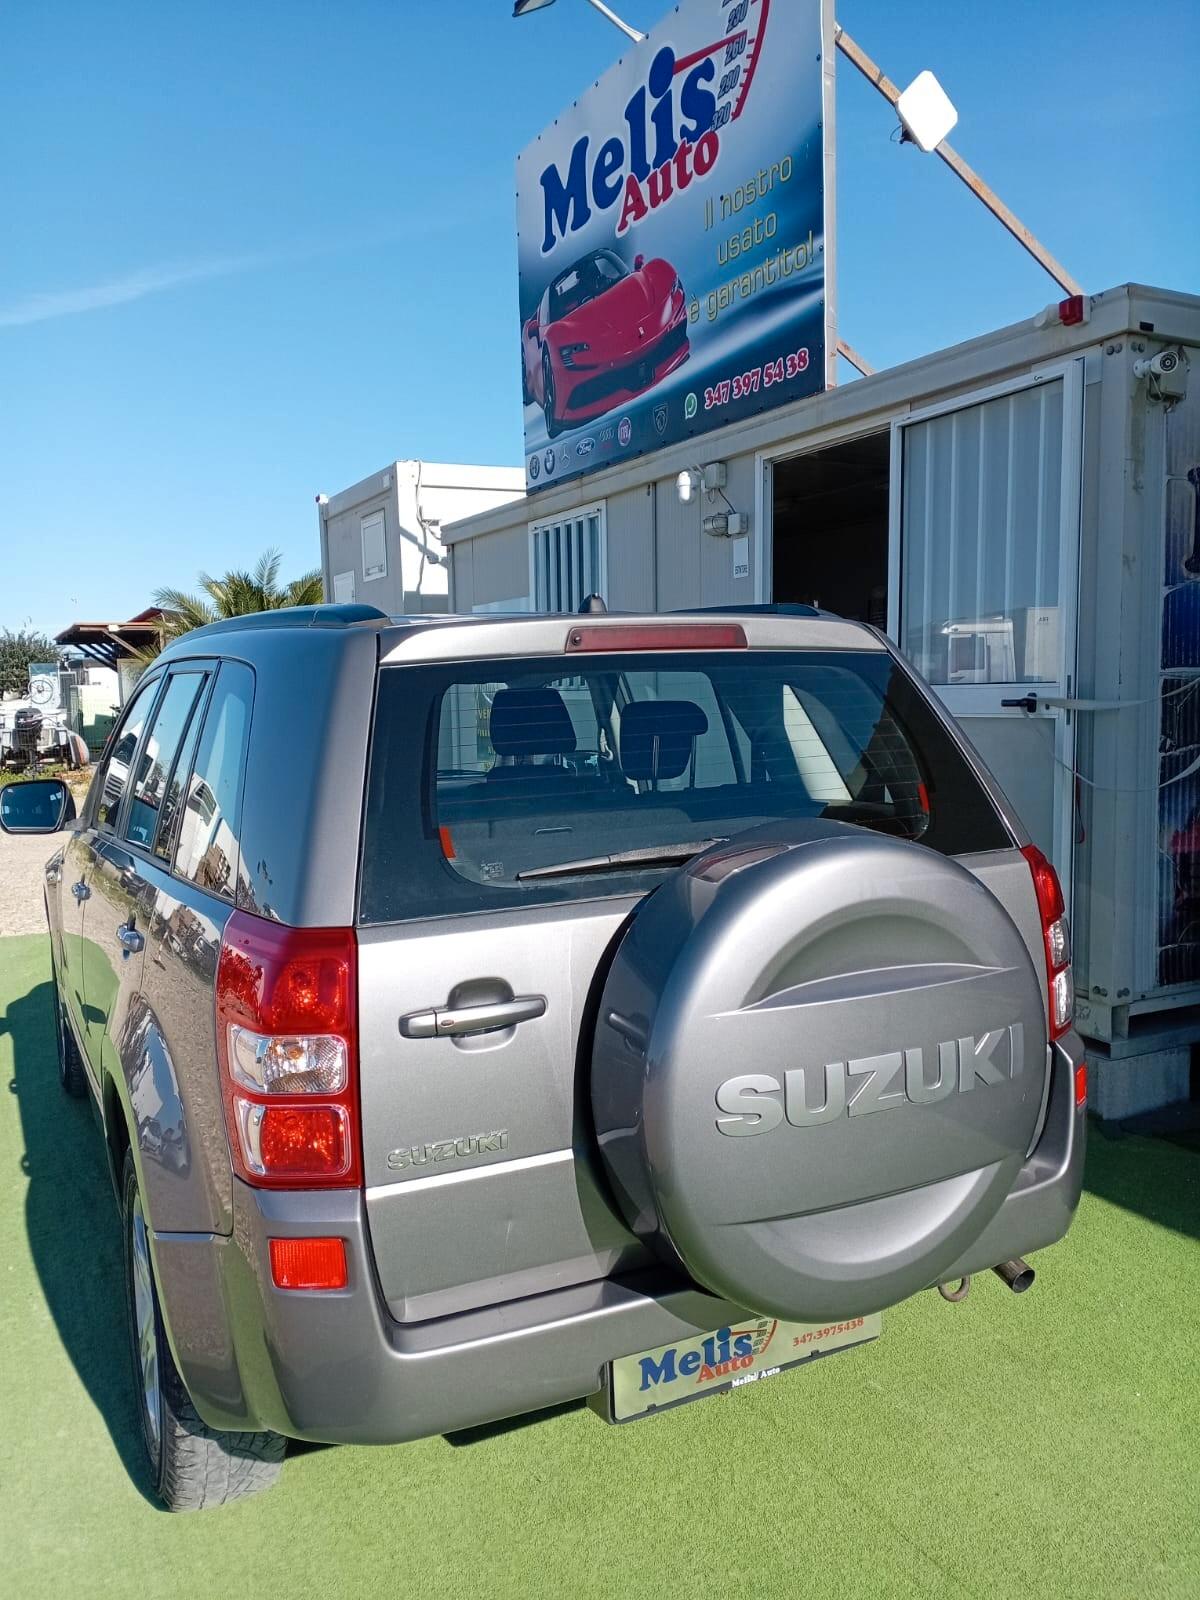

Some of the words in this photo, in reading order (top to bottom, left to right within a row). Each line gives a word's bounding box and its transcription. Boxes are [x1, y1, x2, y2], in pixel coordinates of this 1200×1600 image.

[709, 101, 731, 132] 320
[540, 46, 717, 253] Melis
[617, 131, 719, 233] Auto
[704, 197, 714, 231] Il
[720, 155, 792, 221] nostro
[718, 212, 777, 265] usato
[688, 294, 700, 323] è
[706, 230, 814, 321] garantito!
[704, 380, 731, 409] 347
[732, 368, 761, 398] 397
[763, 358, 784, 387] 54
[786, 348, 809, 378] 38
[715, 1023, 1024, 1137] SUZUKI
[387, 1130, 508, 1170] SUZUKI
[638, 1327, 753, 1391] Melis
[696, 1355, 754, 1383] Auto
[760, 1367, 780, 1379] Auto
